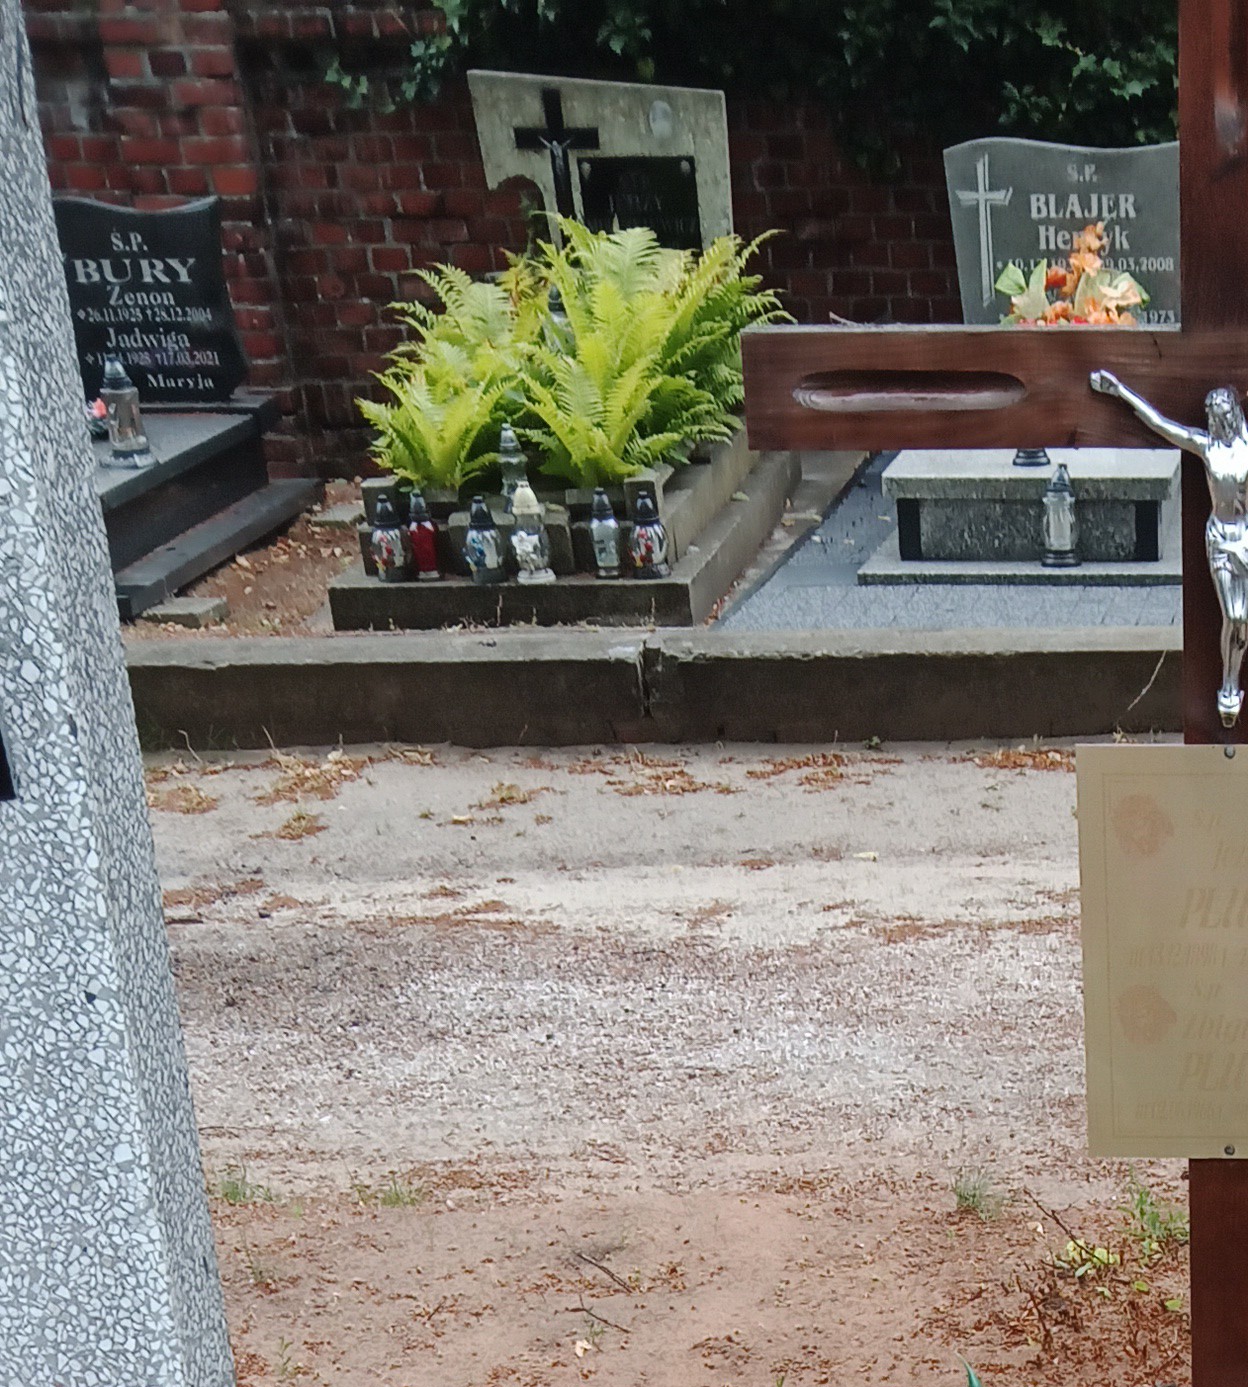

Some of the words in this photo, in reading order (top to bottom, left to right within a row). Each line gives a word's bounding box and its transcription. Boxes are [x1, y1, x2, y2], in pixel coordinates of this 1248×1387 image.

[1030, 193, 1137, 219] BLAJER
[72, 257, 196, 284] BURY
[107, 285, 175, 306] Zenon
[106, 327, 191, 351] Jadwiga
[147, 373, 215, 389] Maryja
